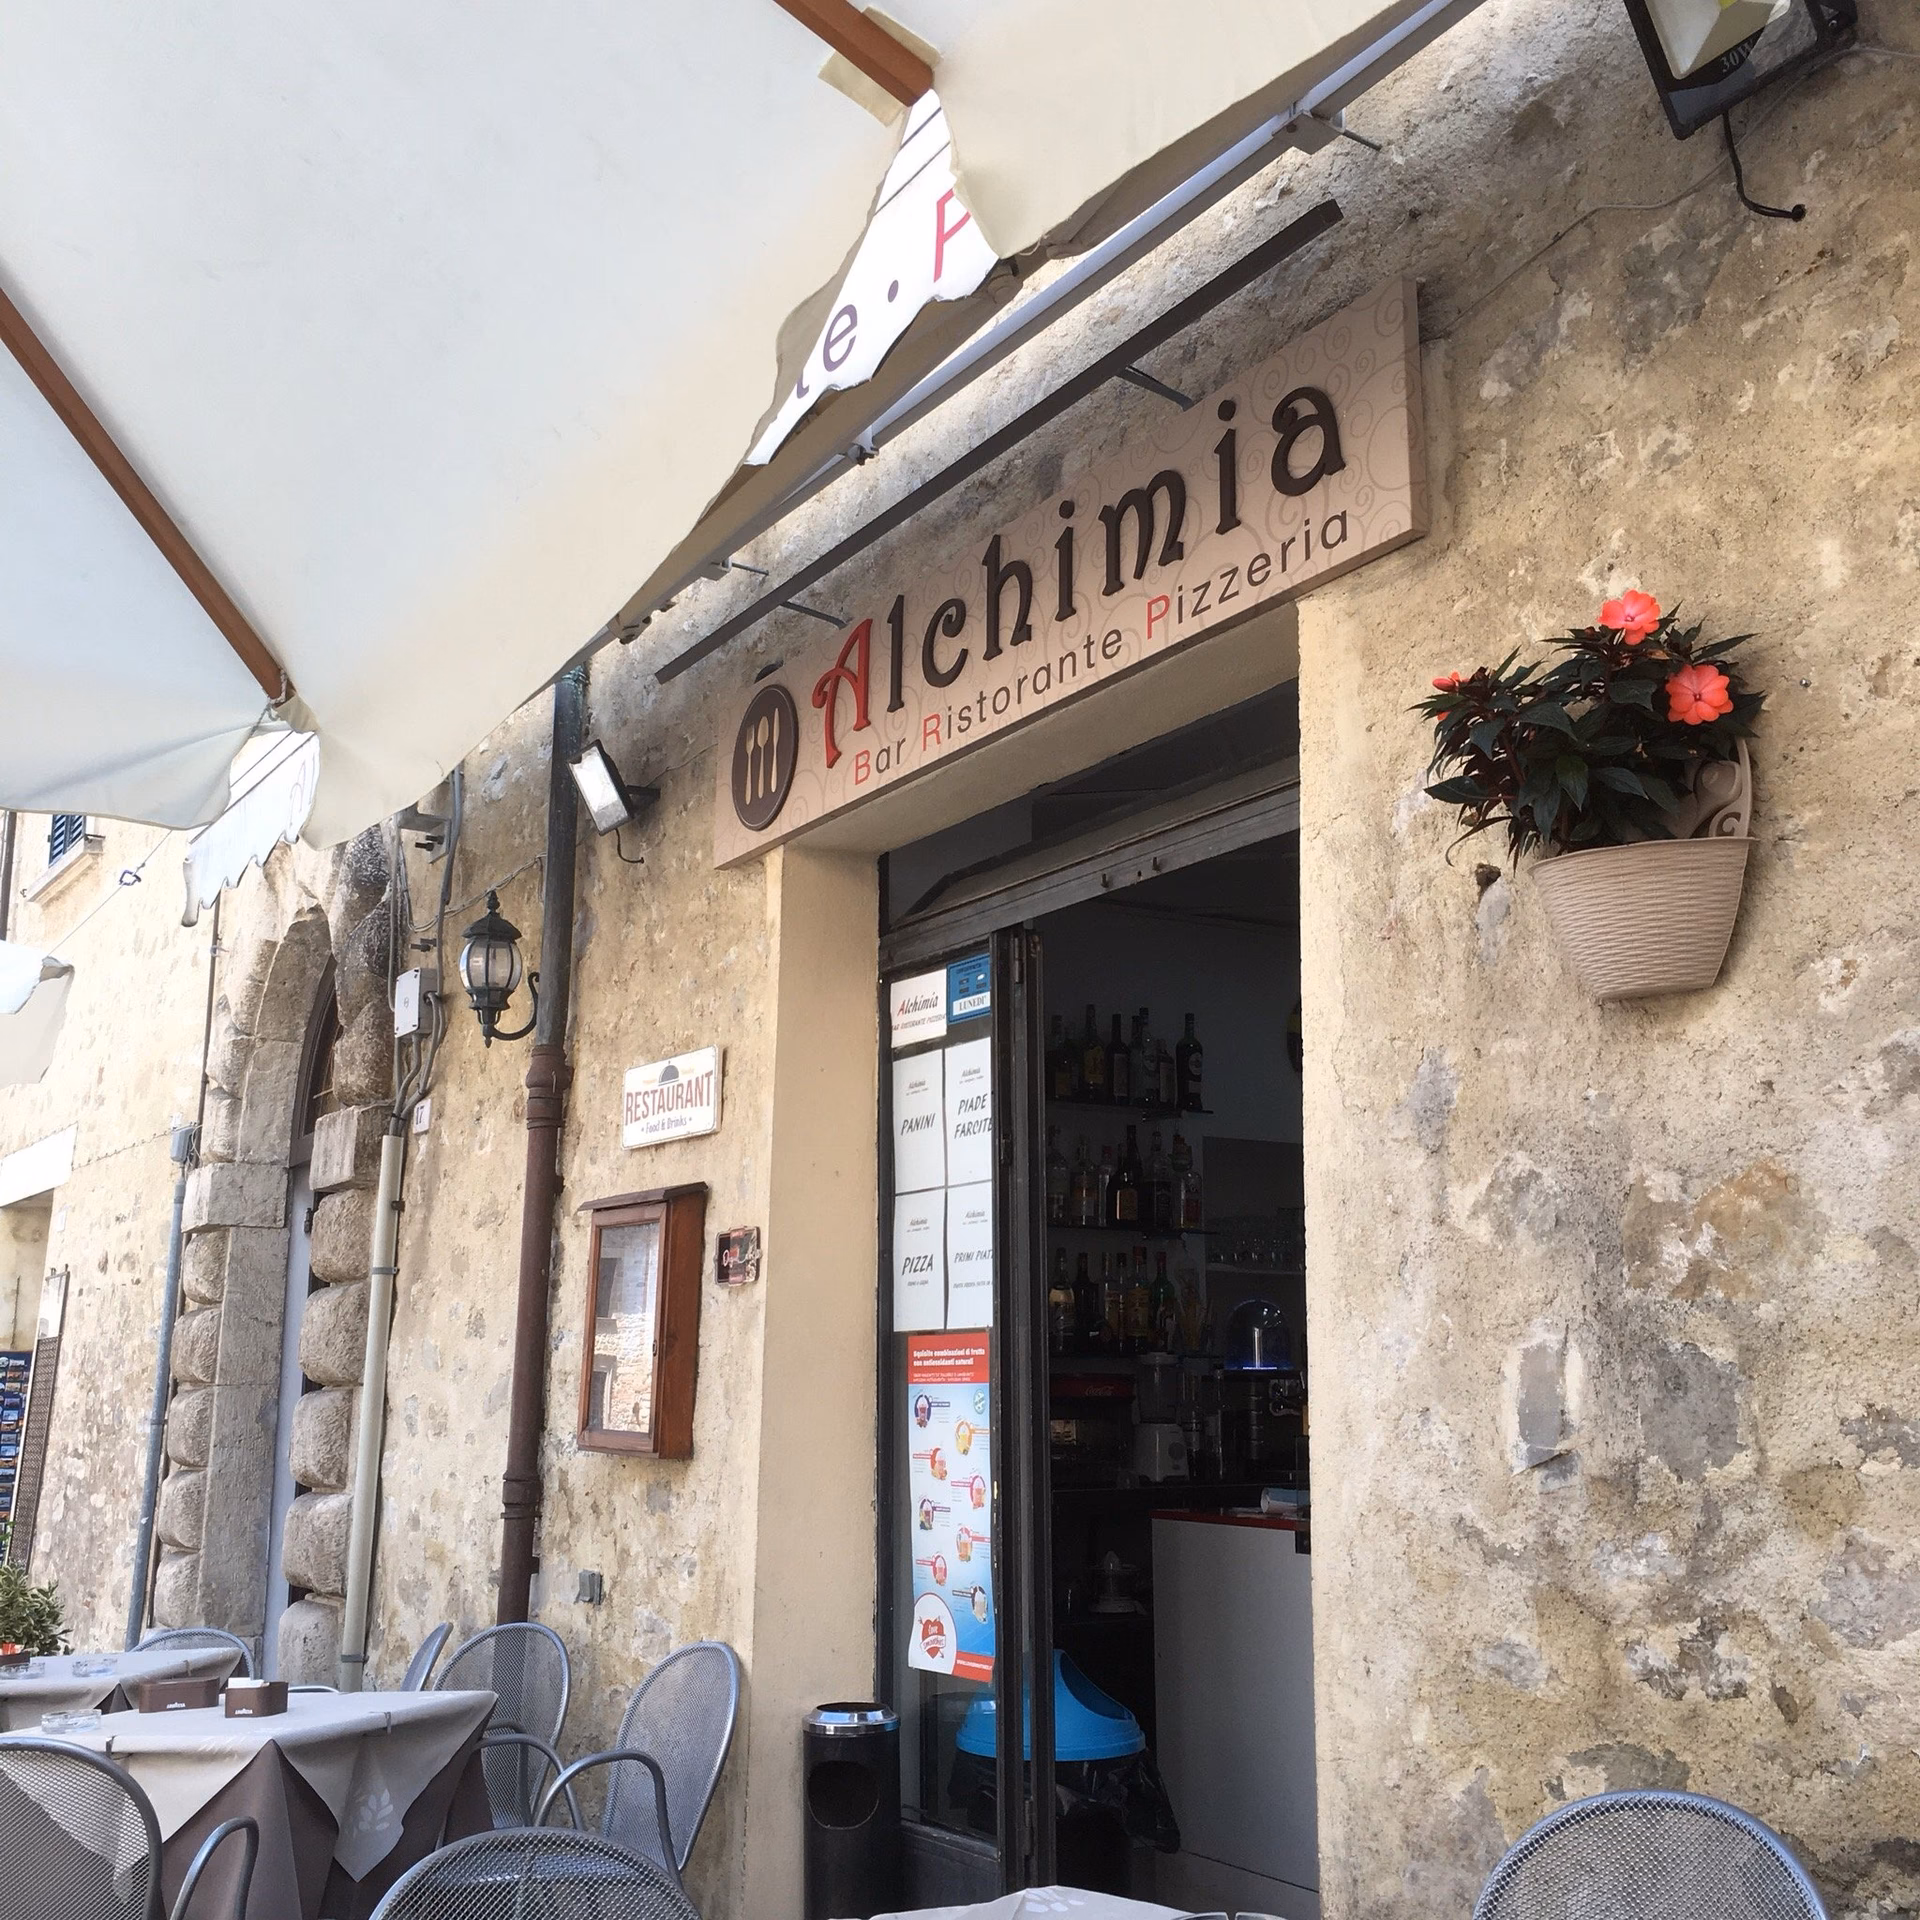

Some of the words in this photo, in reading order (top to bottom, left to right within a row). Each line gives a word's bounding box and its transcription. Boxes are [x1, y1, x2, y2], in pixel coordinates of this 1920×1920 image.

[812, 386, 1346, 769] Alchimia
[855, 737, 906, 785] Bar
[922, 628, 1122, 752] Ristorante
[1147, 510, 1348, 640] Pizzeria
[897, 991, 939, 1016] Alchimia
[625, 1069, 714, 1126] RESTAURANT
[958, 1093, 988, 1115] PIADE
[415, 1105, 425, 1125] 17
[646, 1120, 660, 1134] Food
[661, 1118, 666, 1131] &
[667, 1115, 688, 1130] Drinks
[901, 1113, 936, 1136] PANINI
[902, 1254, 934, 1276] PIZZA
[954, 1251, 974, 1264] PRIMI
